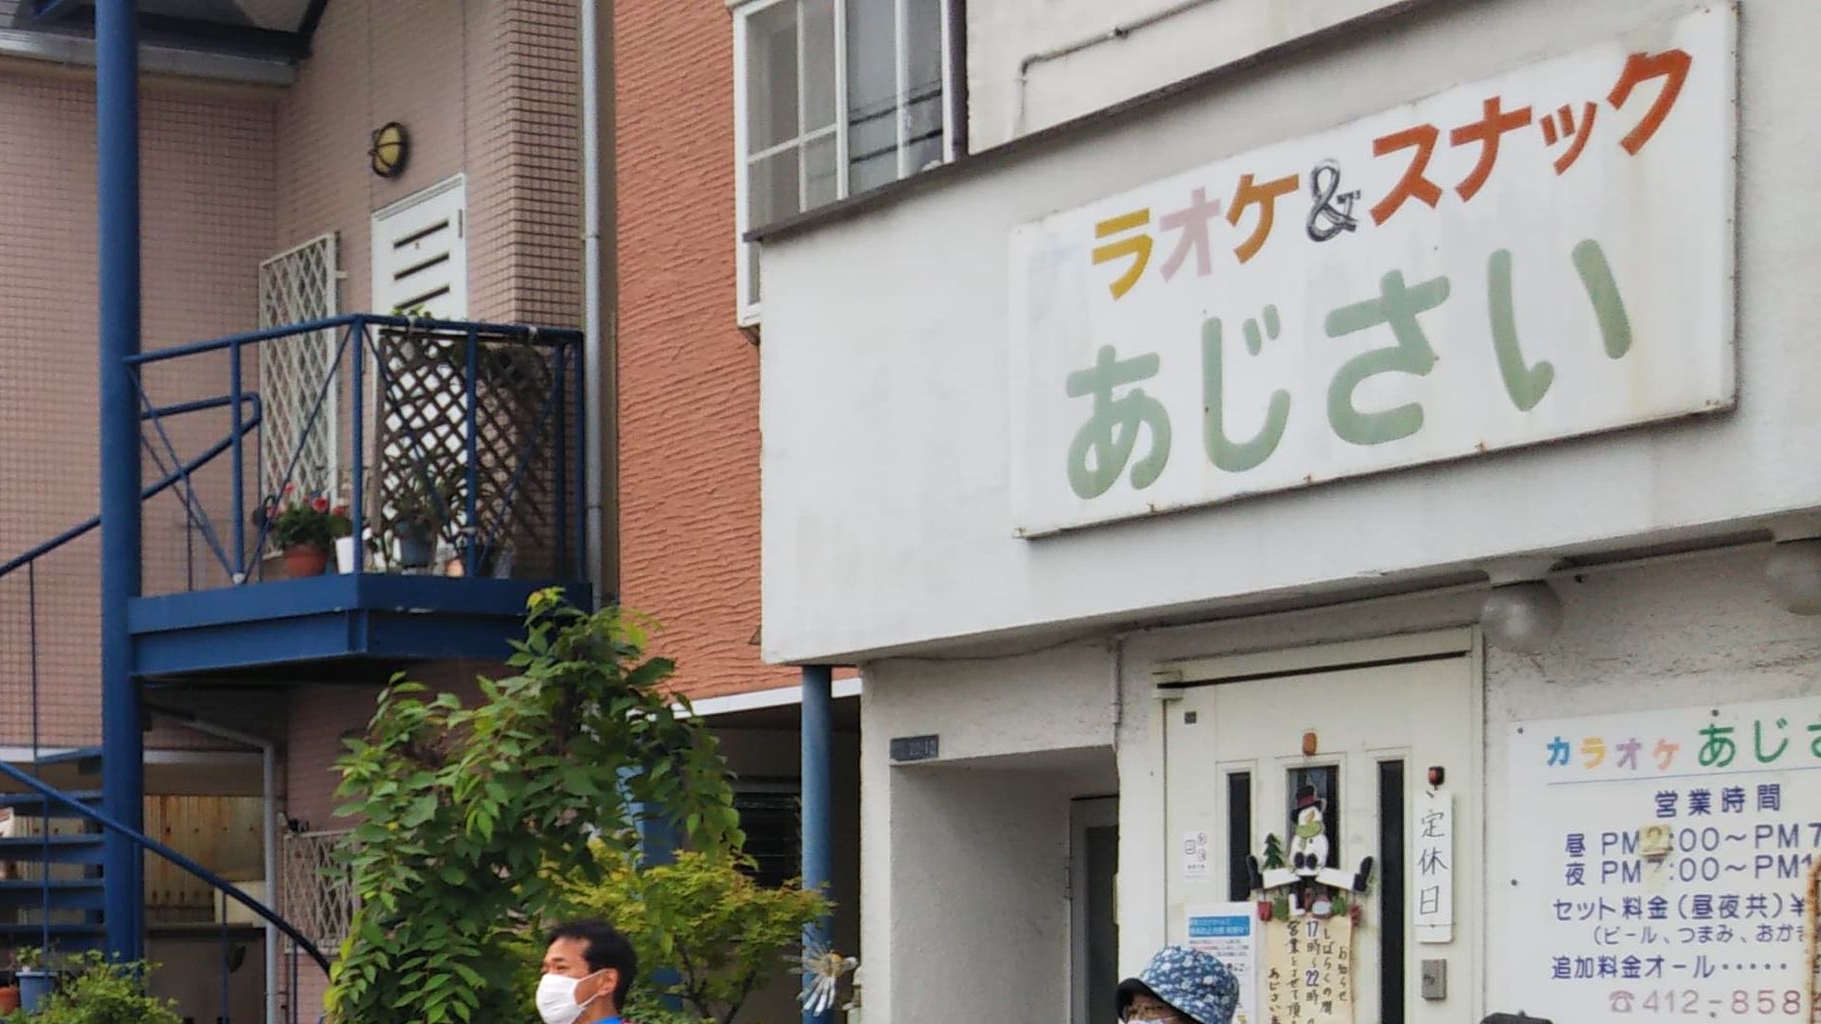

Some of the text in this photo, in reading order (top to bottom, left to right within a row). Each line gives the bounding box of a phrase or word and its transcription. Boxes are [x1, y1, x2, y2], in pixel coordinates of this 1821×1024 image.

[1065, 238, 1633, 500] あじさい
[1546, 736, 1679, 770] カラオケ
[1654, 784, 1781, 818] 営業時間
[1417, 809, 1449, 916] 定休日
